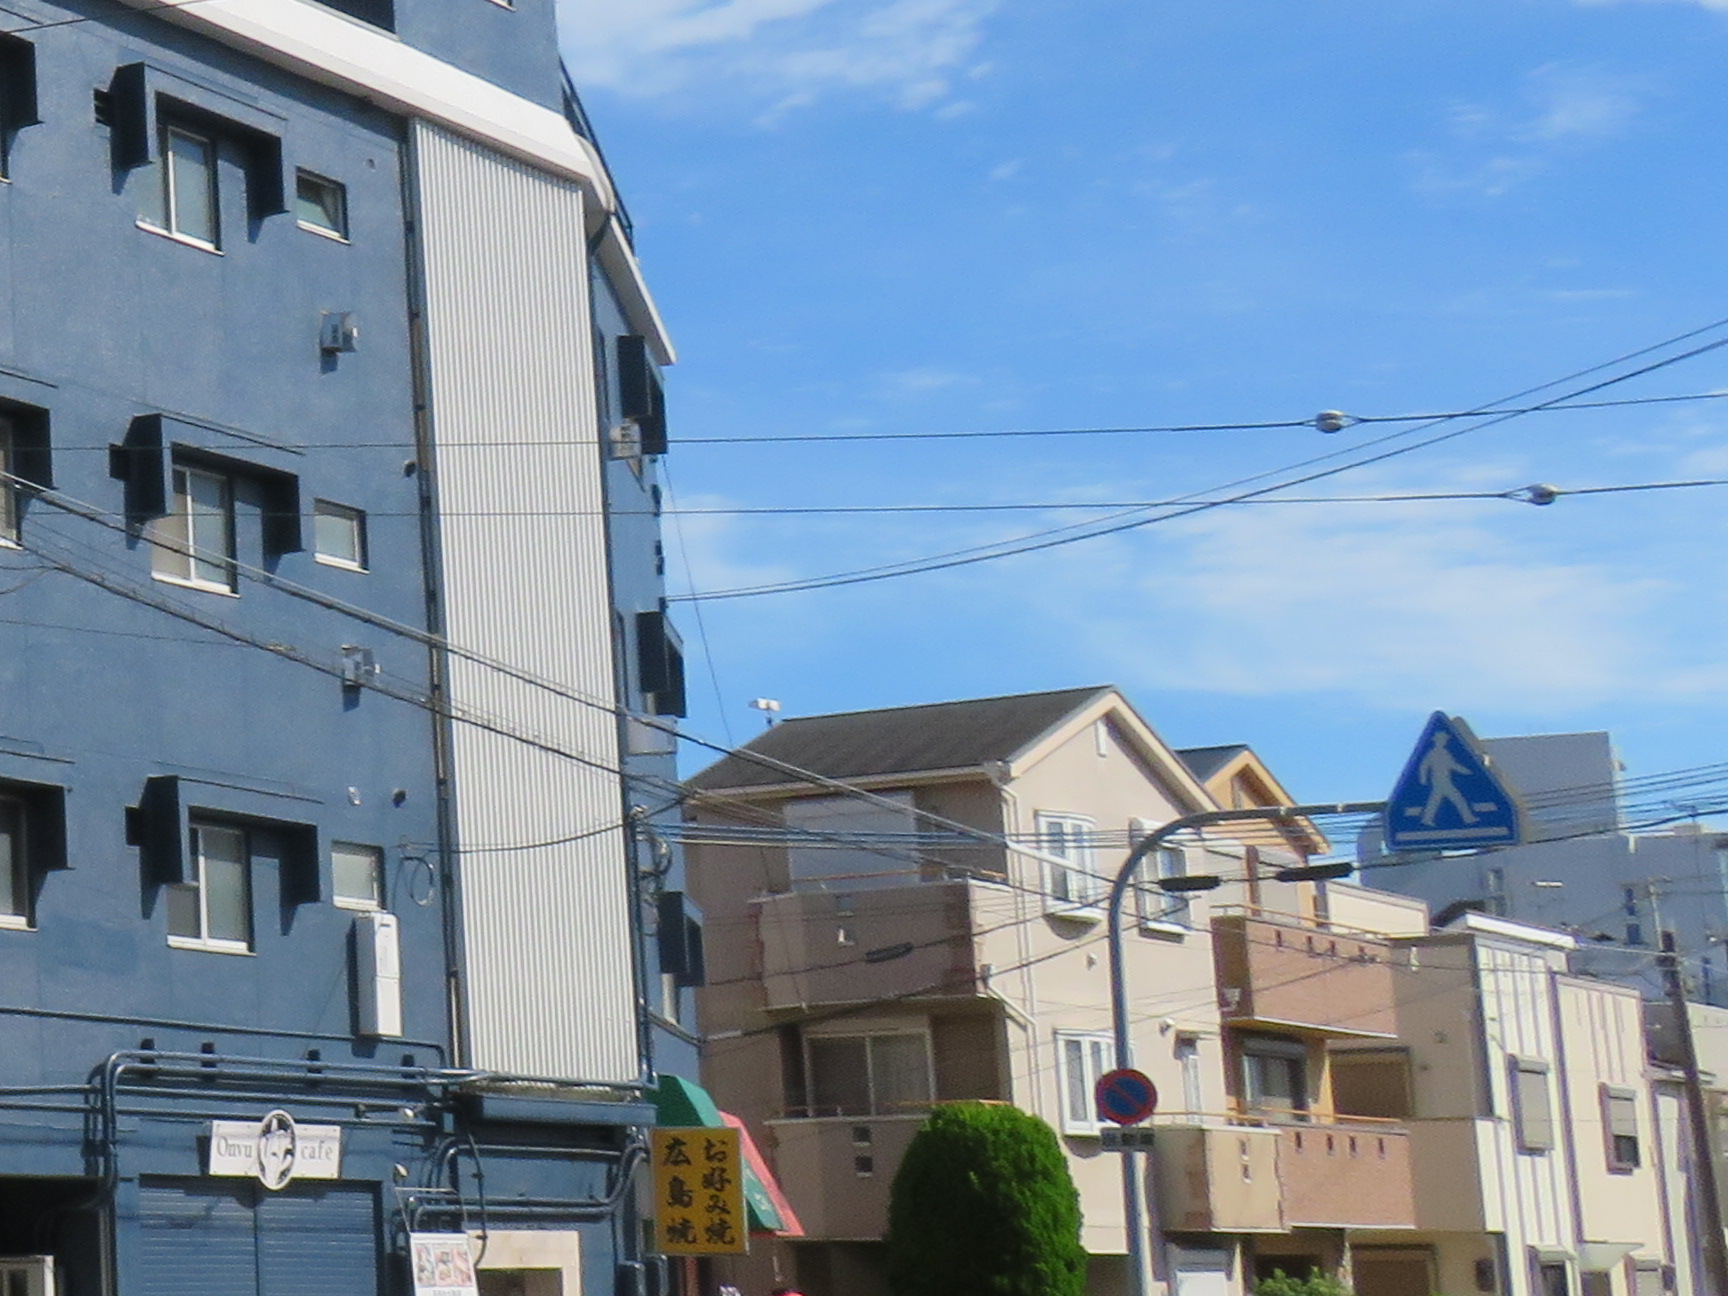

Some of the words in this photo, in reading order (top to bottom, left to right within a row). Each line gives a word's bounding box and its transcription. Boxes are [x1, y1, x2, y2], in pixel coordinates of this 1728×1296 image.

[300, 1139, 334, 1161] cafe
[665, 1136, 697, 1244] 広島焼
[702, 1137, 735, 1245] お好み焼
